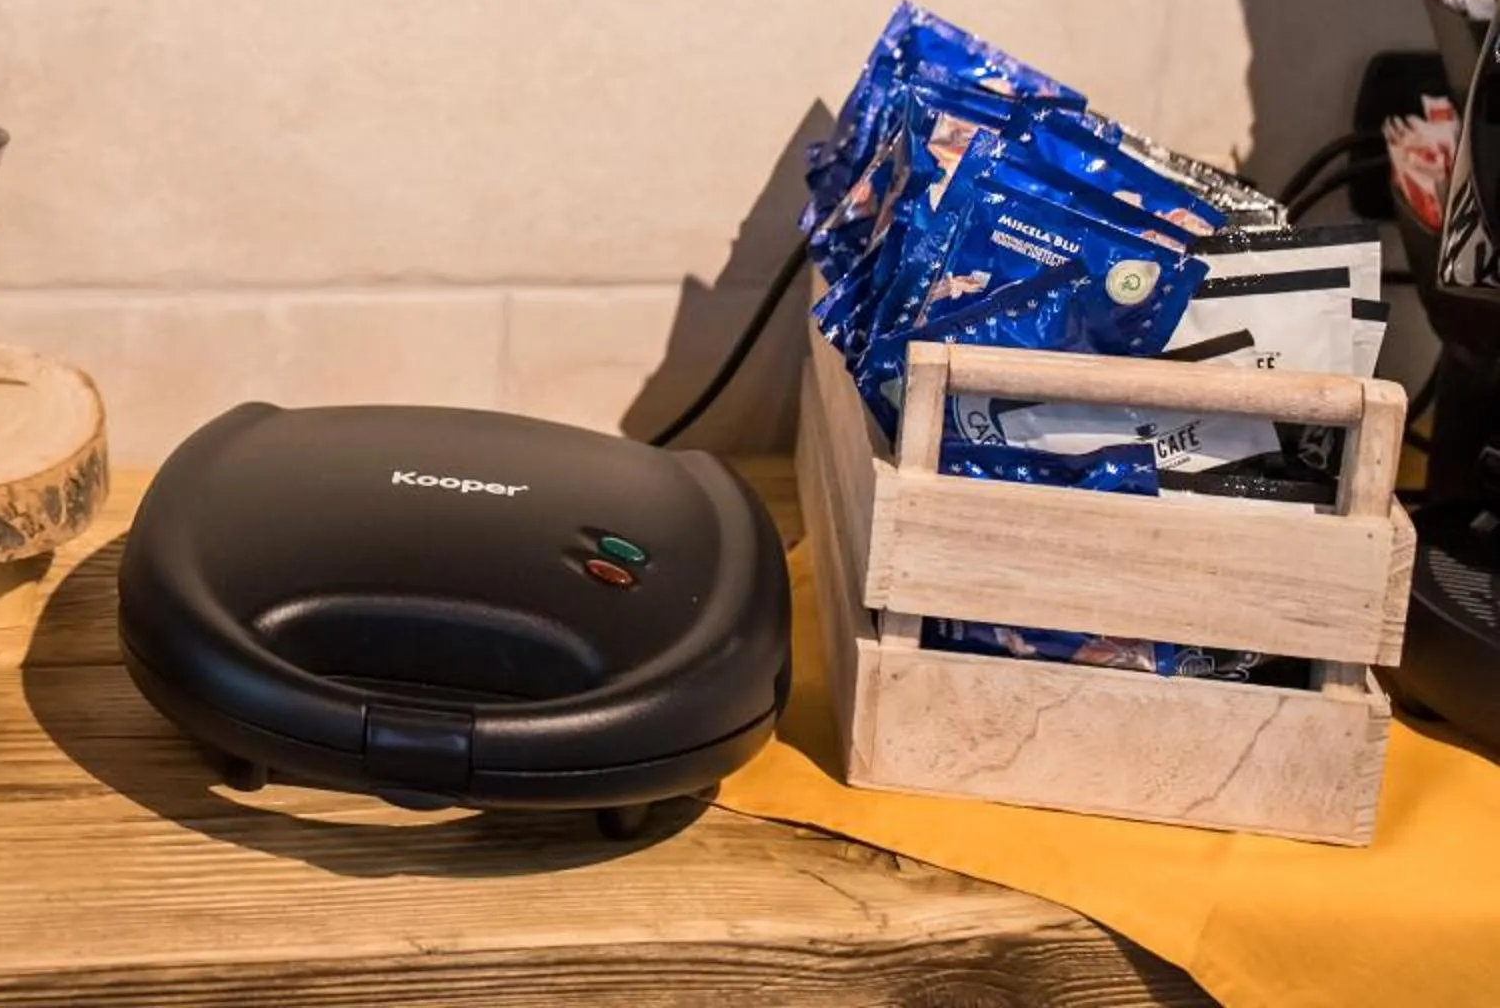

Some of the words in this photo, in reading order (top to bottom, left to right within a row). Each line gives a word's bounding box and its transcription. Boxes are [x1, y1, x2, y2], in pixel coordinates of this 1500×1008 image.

[997, 214, 1051, 243] MISCELA
[1053, 235, 1080, 253] BLU
[391, 470, 530, 496] Kooper
